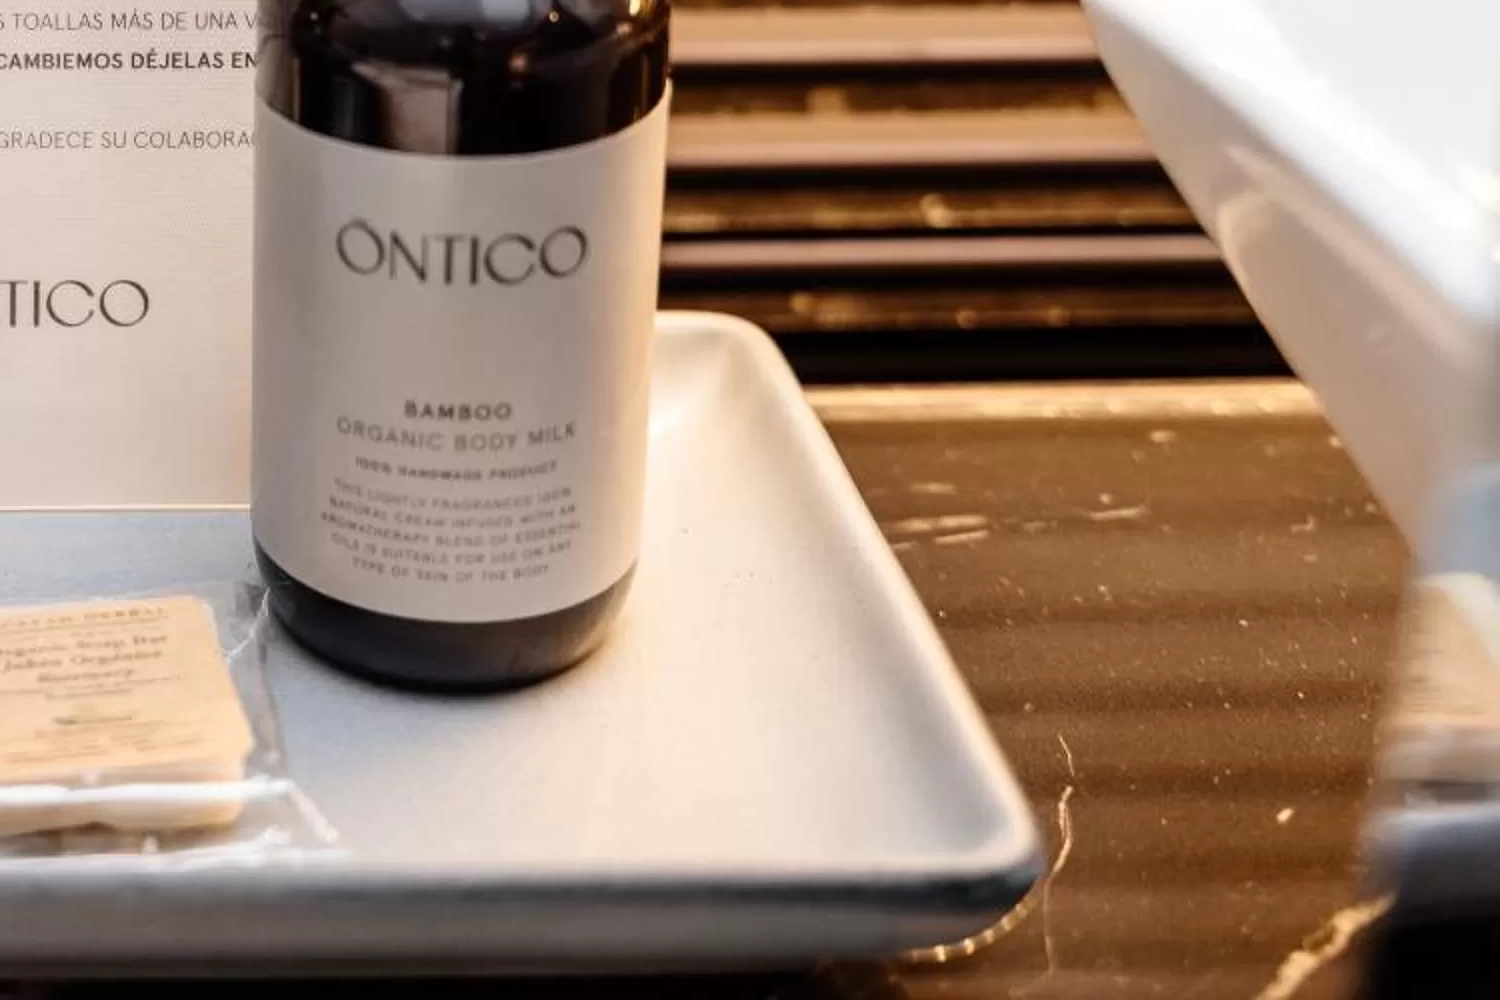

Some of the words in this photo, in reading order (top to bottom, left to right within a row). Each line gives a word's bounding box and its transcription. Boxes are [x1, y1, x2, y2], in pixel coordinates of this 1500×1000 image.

[12, 12, 104, 31] TOALLAS
[110, 8, 154, 31] MÁS
[160, 11, 186, 31] DE
[194, 11, 238, 31] UNA
[130, 47, 225, 70] DÉJELAS
[100, 130, 128, 151] SU
[132, 130, 253, 150] COLABORA
[404, 400, 512, 421] BAMBOO
[336, 415, 445, 450] ORGANIC
[453, 431, 517, 451] BODY
[526, 419, 576, 445] MILK
